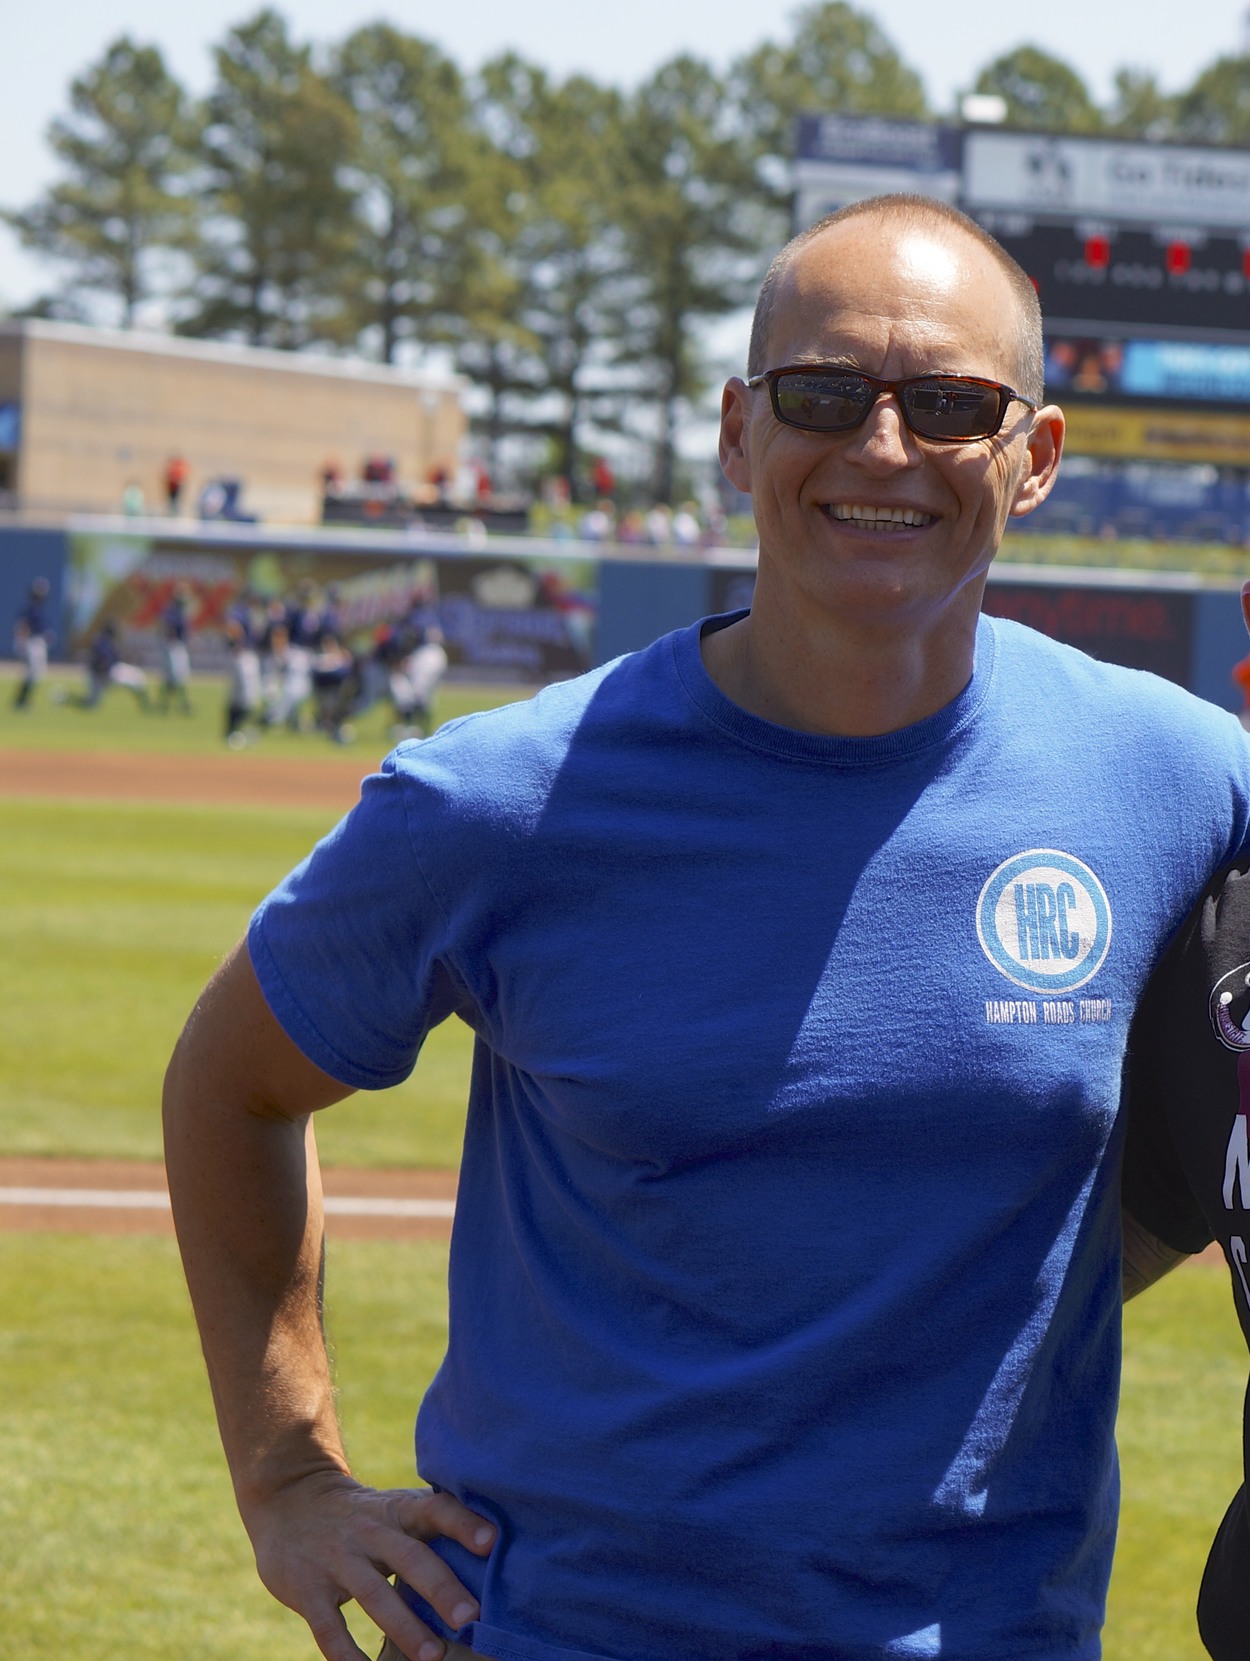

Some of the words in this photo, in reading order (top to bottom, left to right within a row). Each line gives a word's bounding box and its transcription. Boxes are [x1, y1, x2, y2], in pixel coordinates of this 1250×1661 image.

[1014, 882, 1079, 960] HRC
[985, 1001, 1037, 1023] HAMPTON
[1043, 1001, 1075, 1023] ROADS
[1079, 999, 1112, 1022] CHURCH
